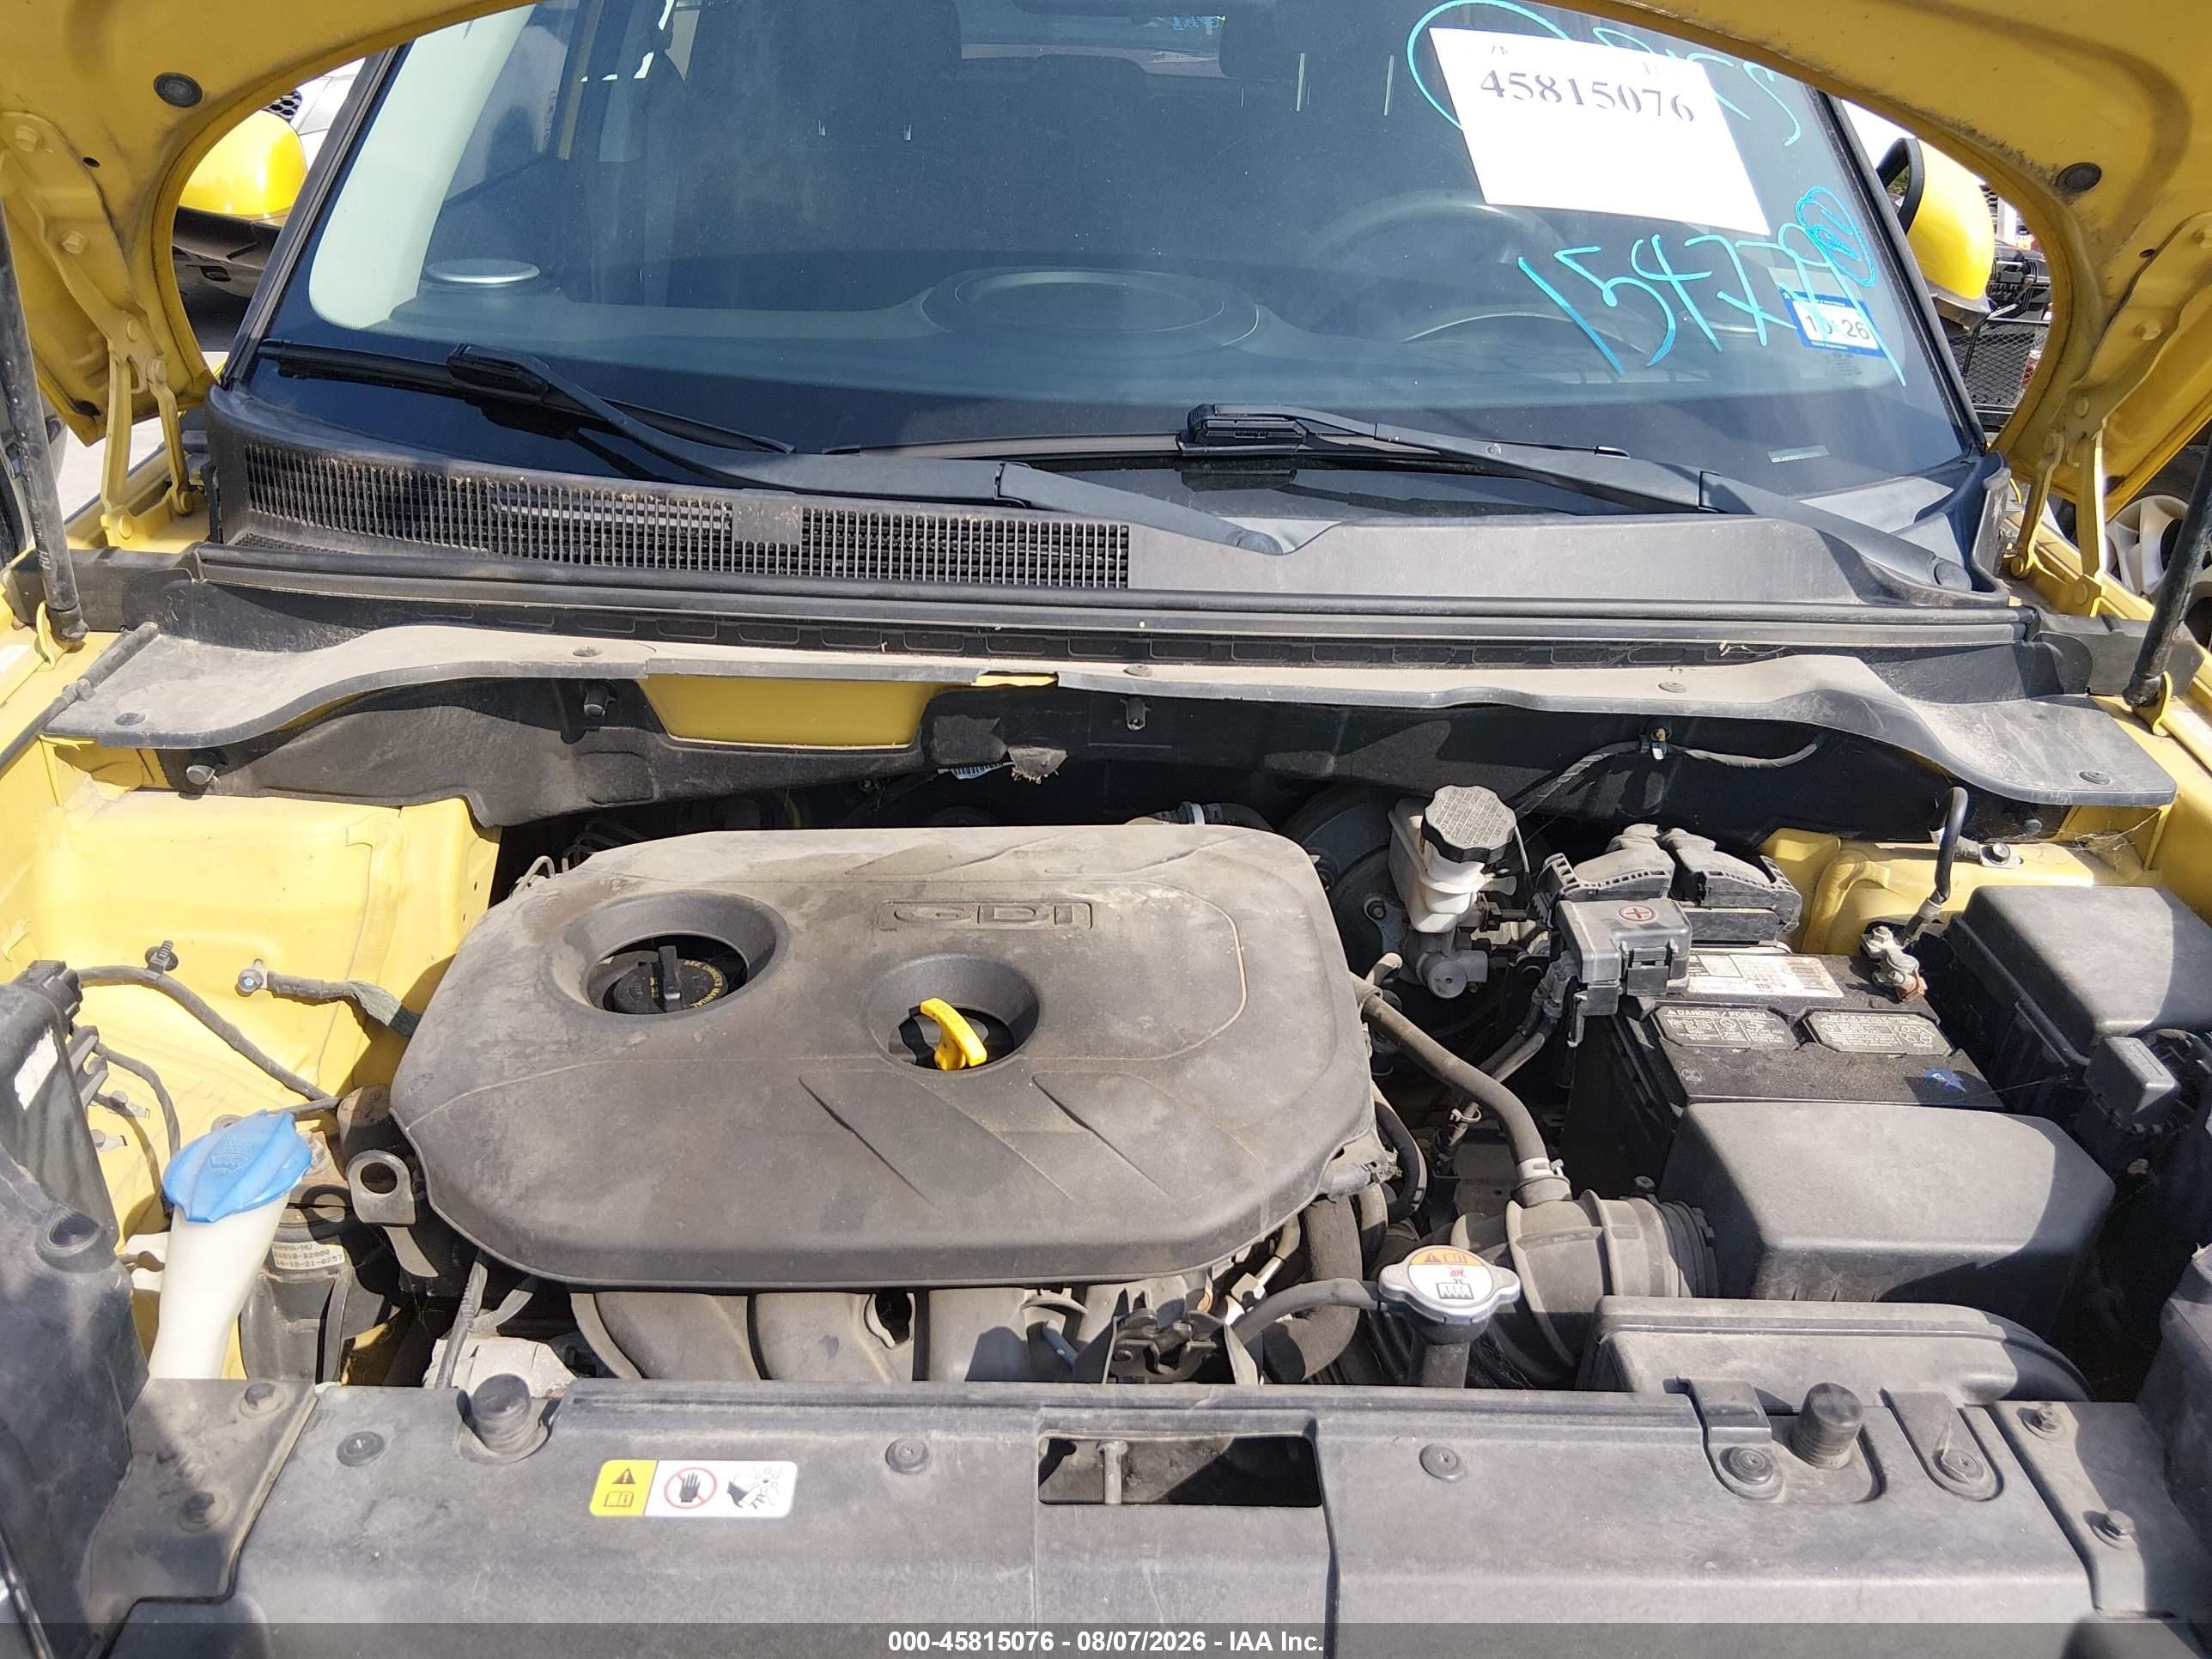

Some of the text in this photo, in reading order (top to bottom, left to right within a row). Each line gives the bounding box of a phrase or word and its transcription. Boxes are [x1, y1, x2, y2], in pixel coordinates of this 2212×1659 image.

[1480, 69, 1695, 123] 45815076
[1841, 319, 1870, 340] 26
[892, 903, 1074, 926] GDI
[1676, 1009, 1719, 1018] DANGER
